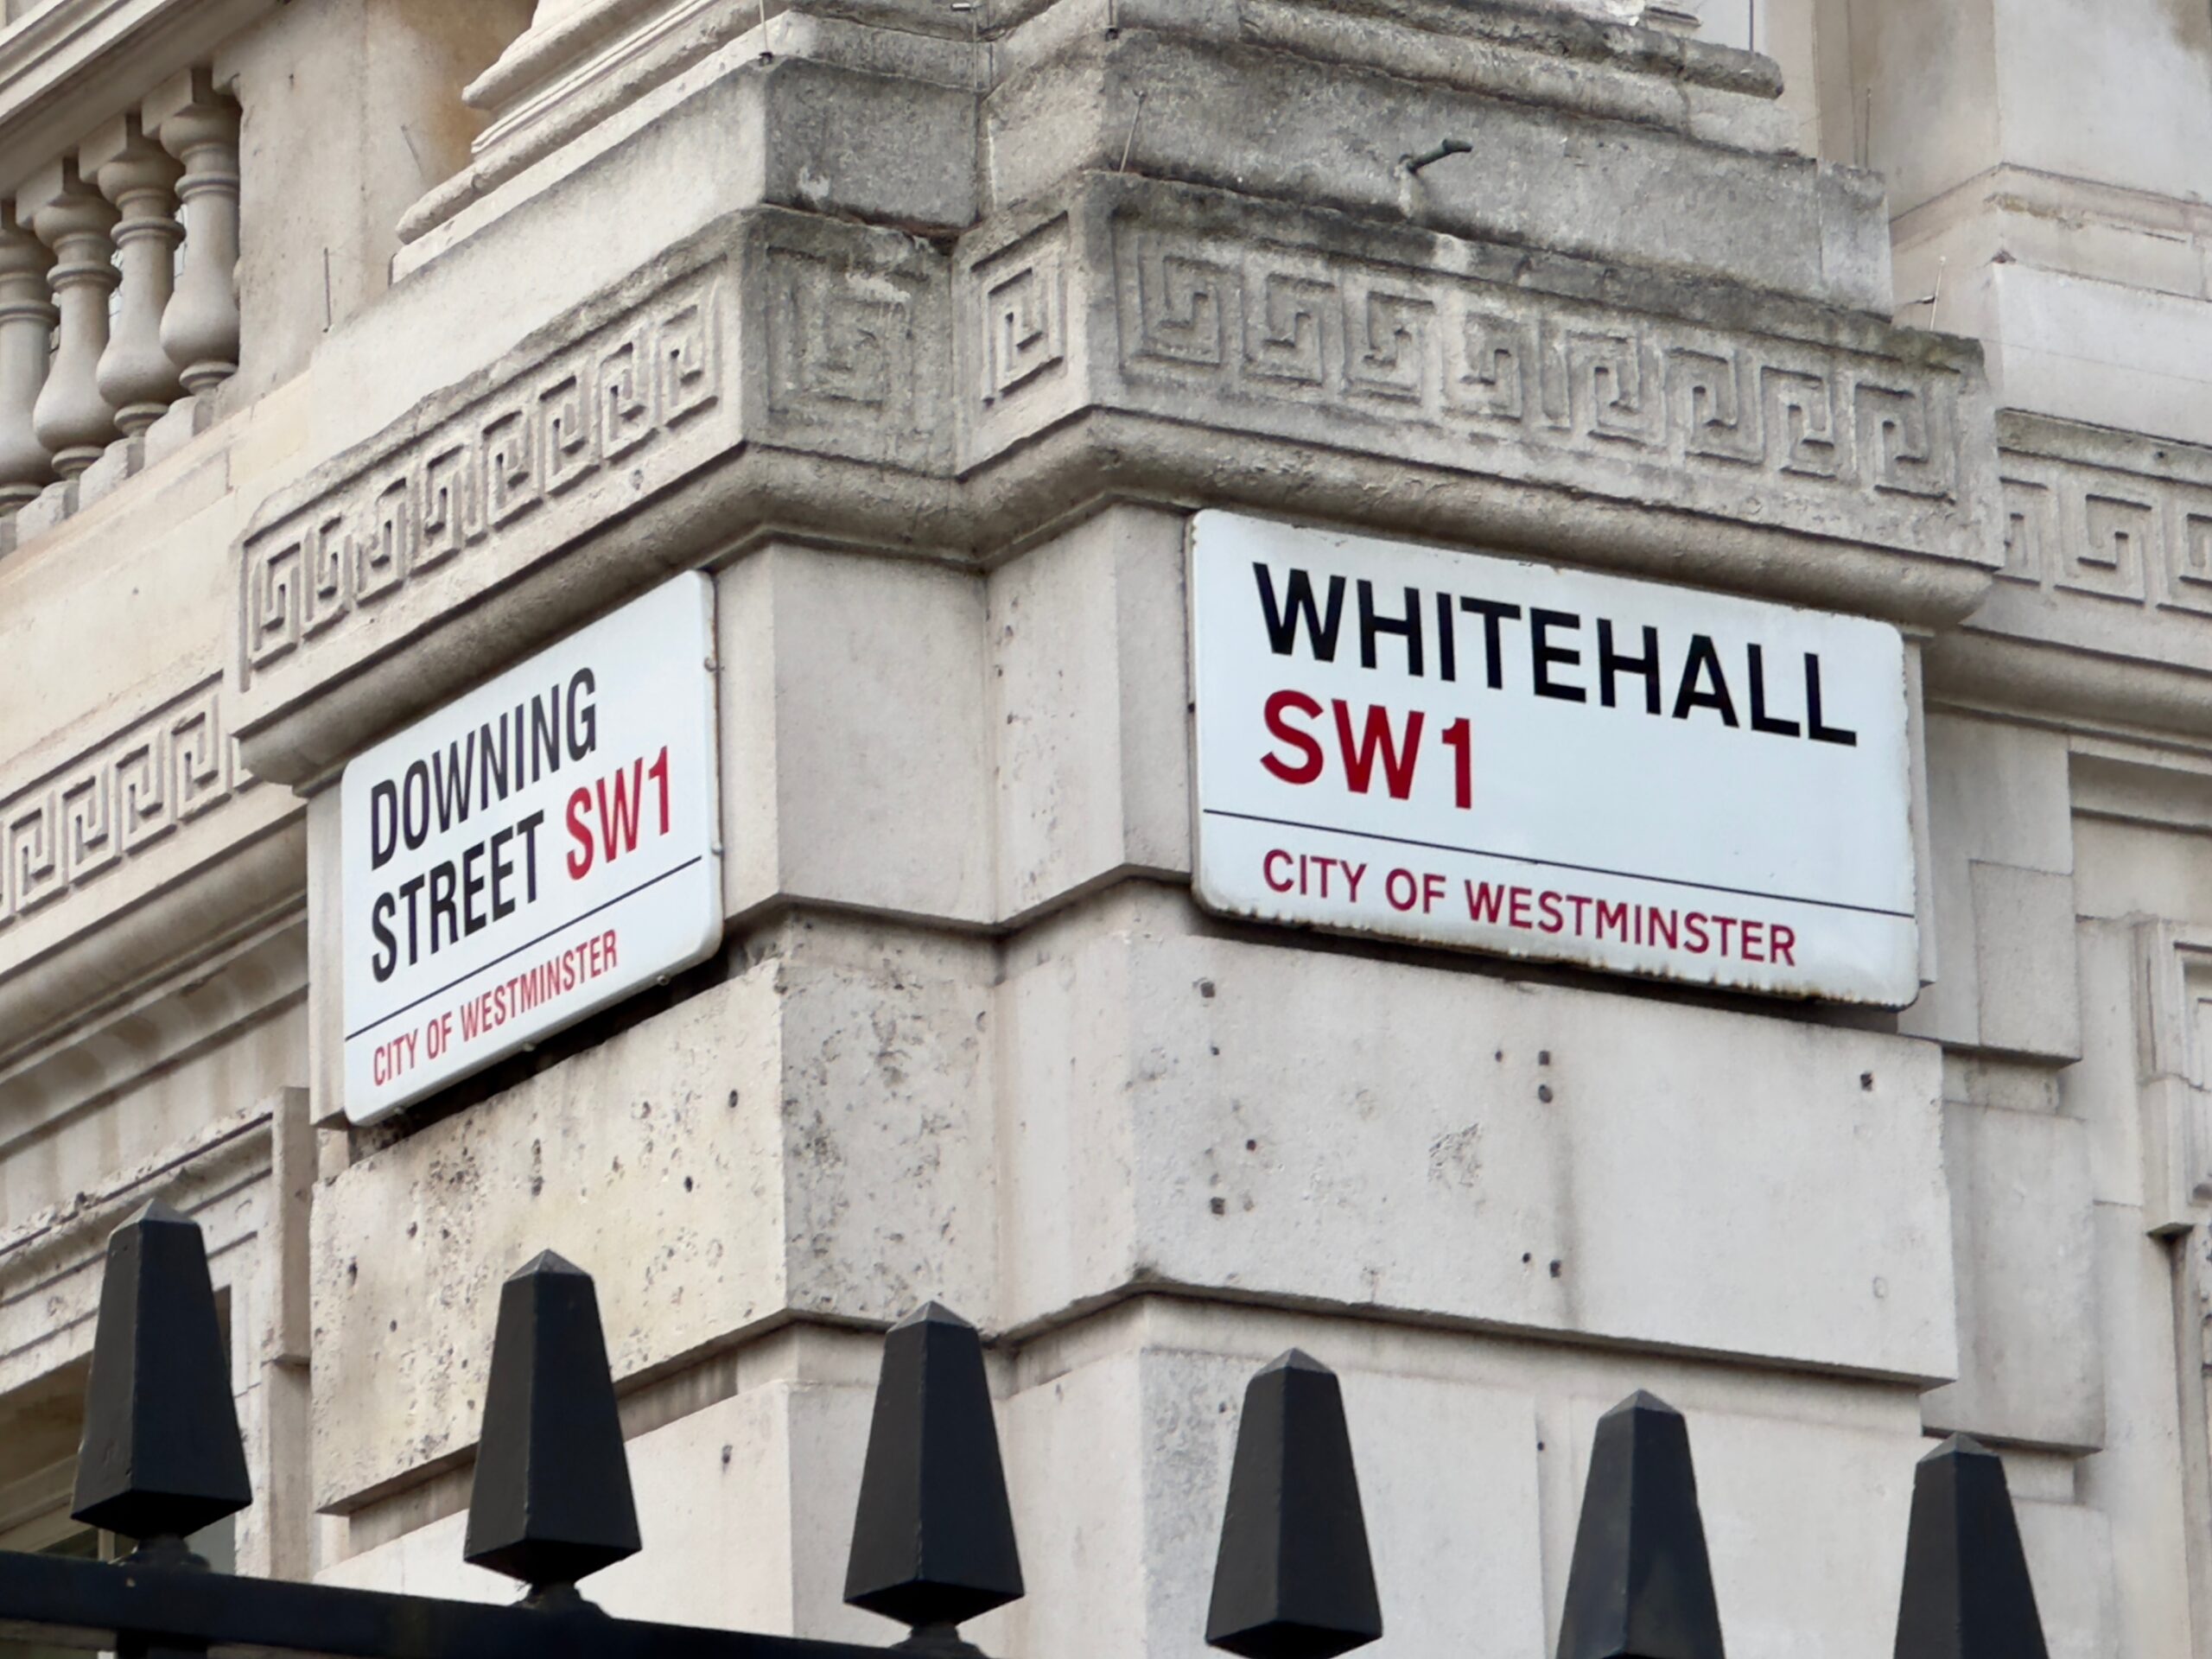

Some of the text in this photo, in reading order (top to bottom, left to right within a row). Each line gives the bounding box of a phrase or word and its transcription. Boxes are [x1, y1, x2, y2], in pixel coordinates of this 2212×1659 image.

[1252, 562, 1857, 747] WHITEHALL
[372, 667, 597, 871] DOWNING
[1259, 689, 1472, 810] SW1
[372, 746, 669, 983] STREET SW1
[1263, 849, 1796, 967] CITY OF WESTMINSTER
[372, 929, 618, 1087] CITY OF WESTMINSTER
